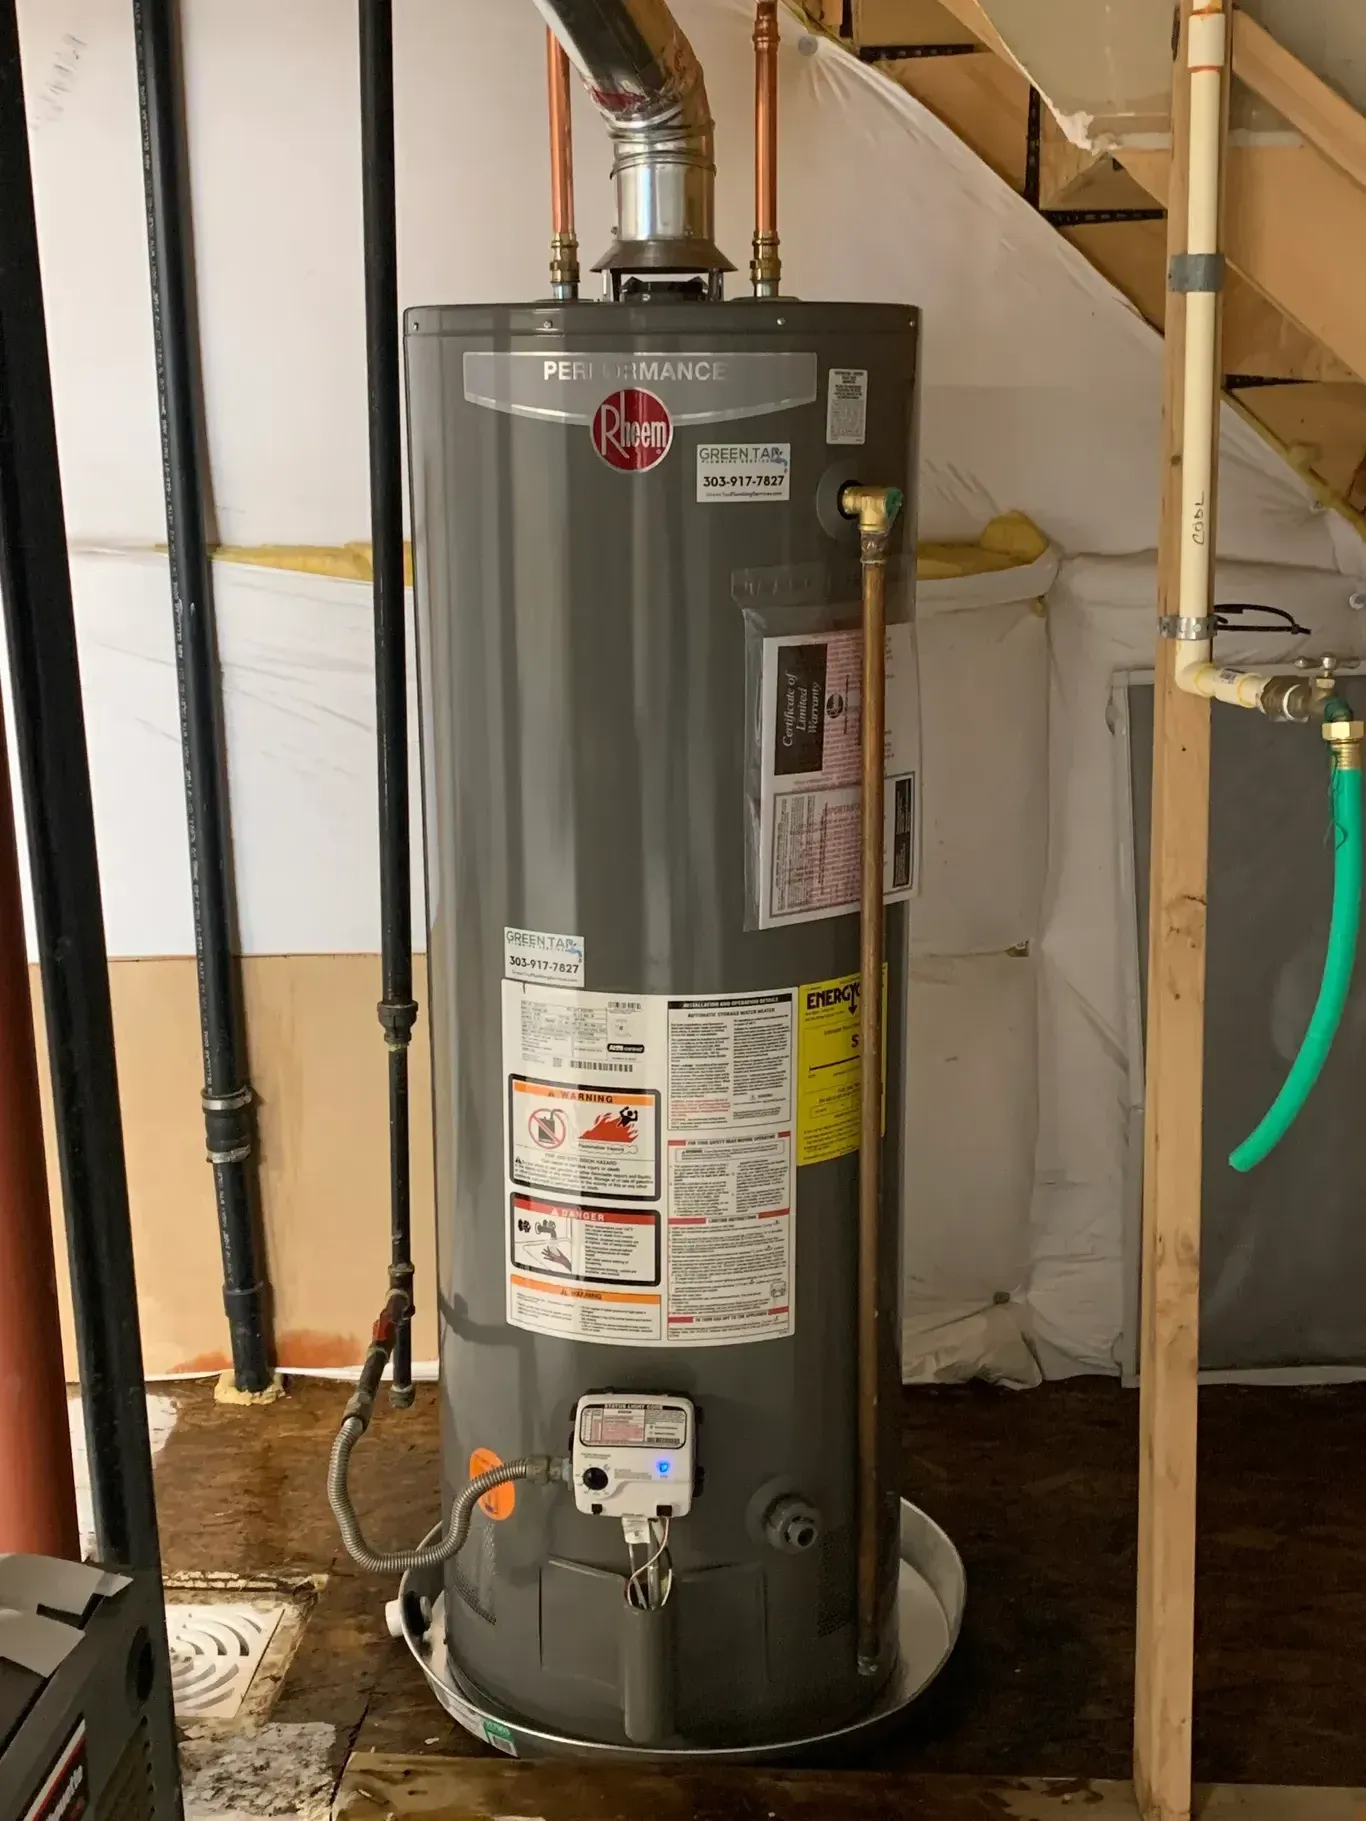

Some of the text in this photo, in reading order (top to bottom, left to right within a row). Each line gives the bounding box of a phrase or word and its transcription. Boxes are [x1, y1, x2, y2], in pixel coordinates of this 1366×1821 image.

[601, 391, 667, 459] Rheem
[699, 447, 749, 460] GREEN
[703, 475, 785, 487] 303-917-7827
[782, 669, 798, 747] Certificate of
[796, 687, 809, 731] Limited
[807, 681, 821, 734] Warranty
[506, 931, 545, 946] GREEN
[509, 956, 580, 974] 303-917-7827
[560, 1091, 613, 1103] WARNING
[562, 1211, 604, 1221] DANGER
